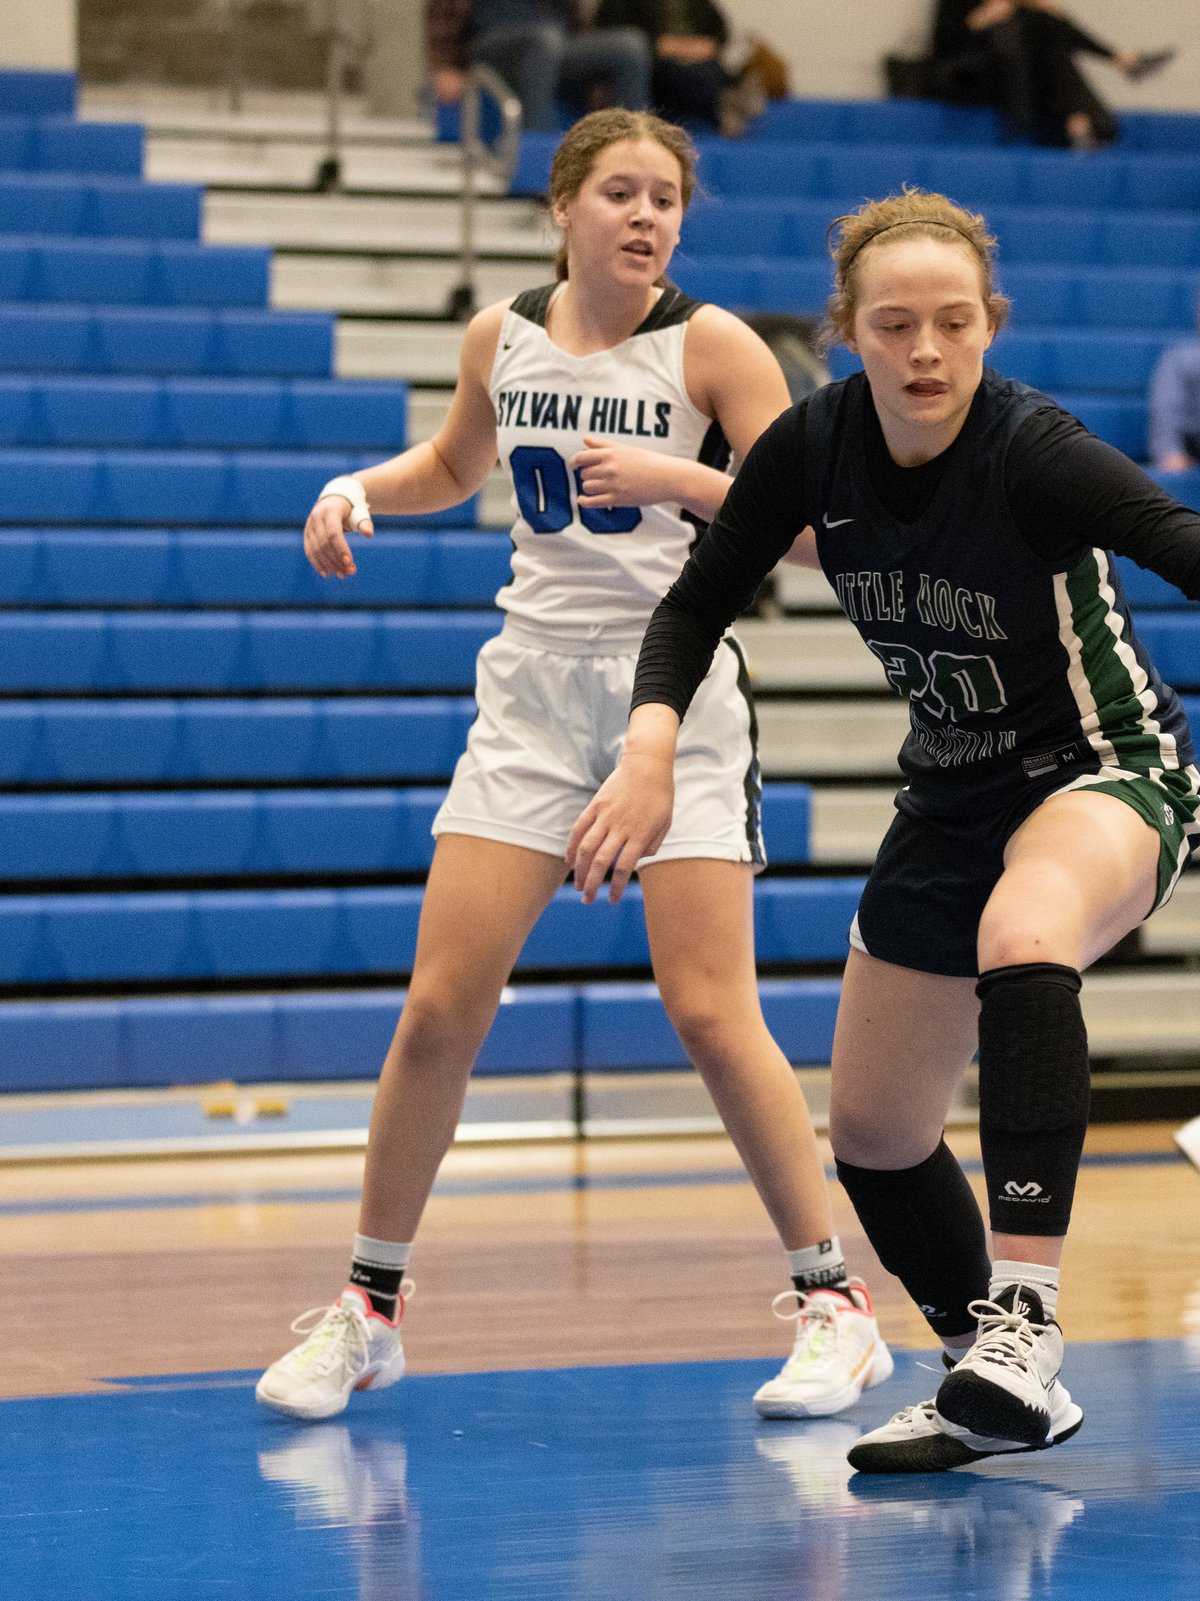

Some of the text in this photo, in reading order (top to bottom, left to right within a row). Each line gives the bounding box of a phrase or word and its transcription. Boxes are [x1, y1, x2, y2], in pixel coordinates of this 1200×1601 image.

[497, 391, 671, 438] SYLVAN HILLS
[917, 573, 1008, 640] ROCK
[866, 639, 1008, 722] 20
[1061, 751, 1076, 764] M
